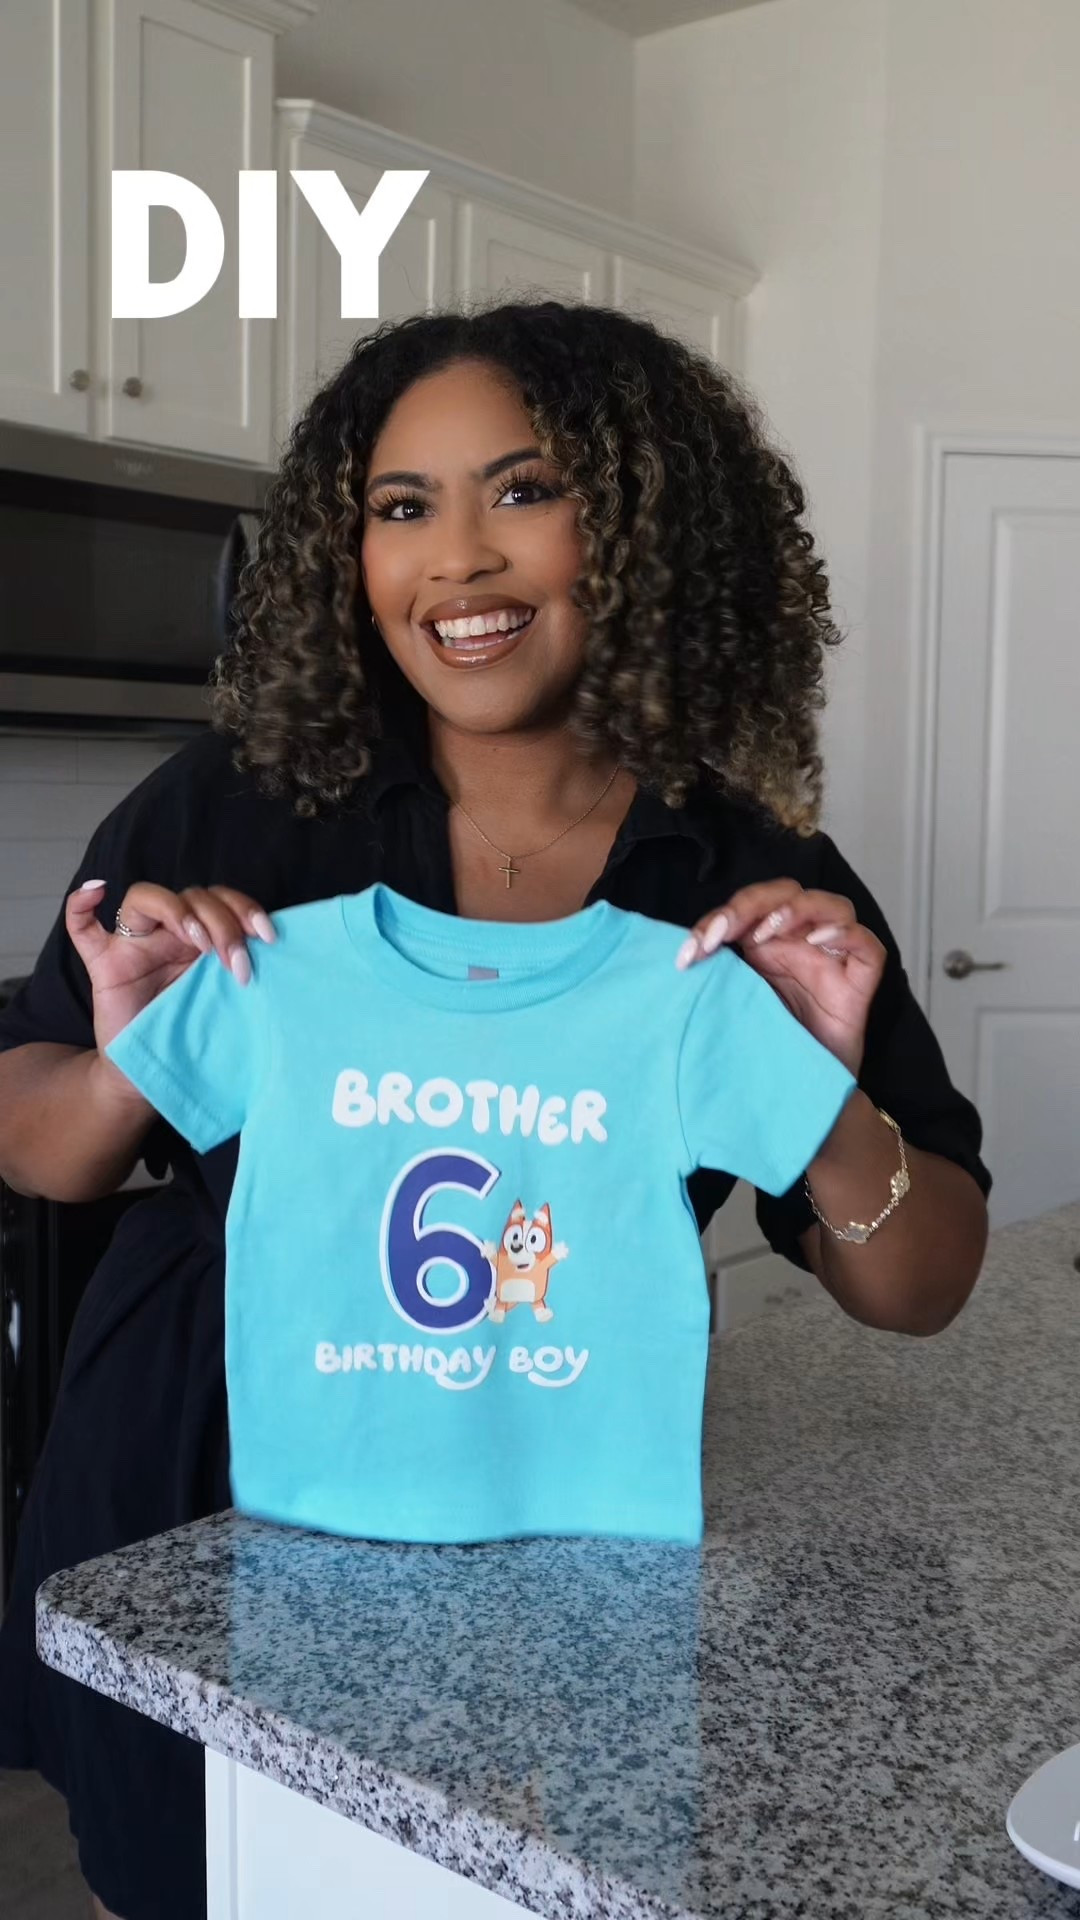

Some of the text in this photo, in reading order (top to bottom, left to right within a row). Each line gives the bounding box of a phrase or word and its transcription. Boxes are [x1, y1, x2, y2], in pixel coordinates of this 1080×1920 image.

[331, 1067, 608, 1146] BROTHER
[378, 1147, 501, 1335] 6
[314, 1341, 590, 1390] BIRTHDAY BOY
